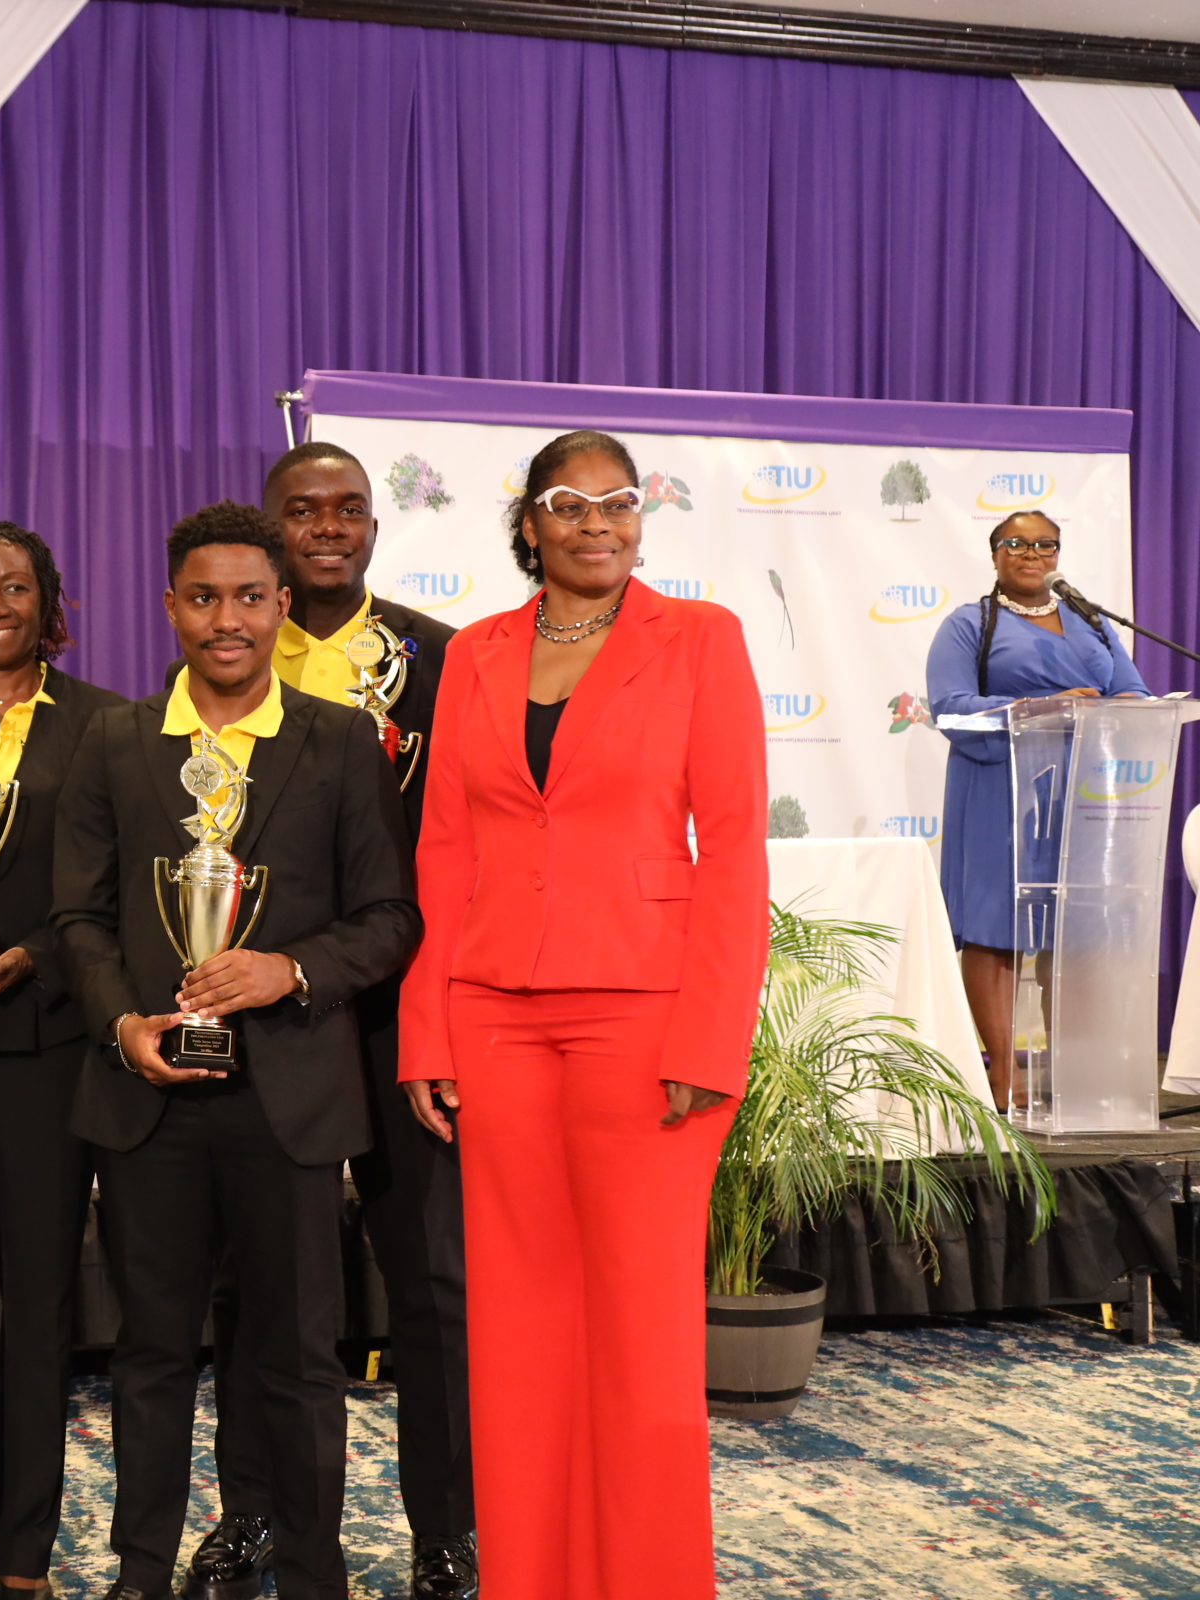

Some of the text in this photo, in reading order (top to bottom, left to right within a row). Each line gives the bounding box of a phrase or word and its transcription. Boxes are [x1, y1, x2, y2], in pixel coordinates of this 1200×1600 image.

[768, 465, 812, 489] TIU
[1002, 474, 1044, 496] TIU
[737, 507, 783, 515] TRANSFORMATION
[413, 573, 459, 596] TIU
[658, 579, 701, 600] TIU
[896, 585, 937, 607] TIU
[770, 694, 811, 717] TIU
[1111, 759, 1154, 784] TIU
[894, 816, 938, 838] TIU
